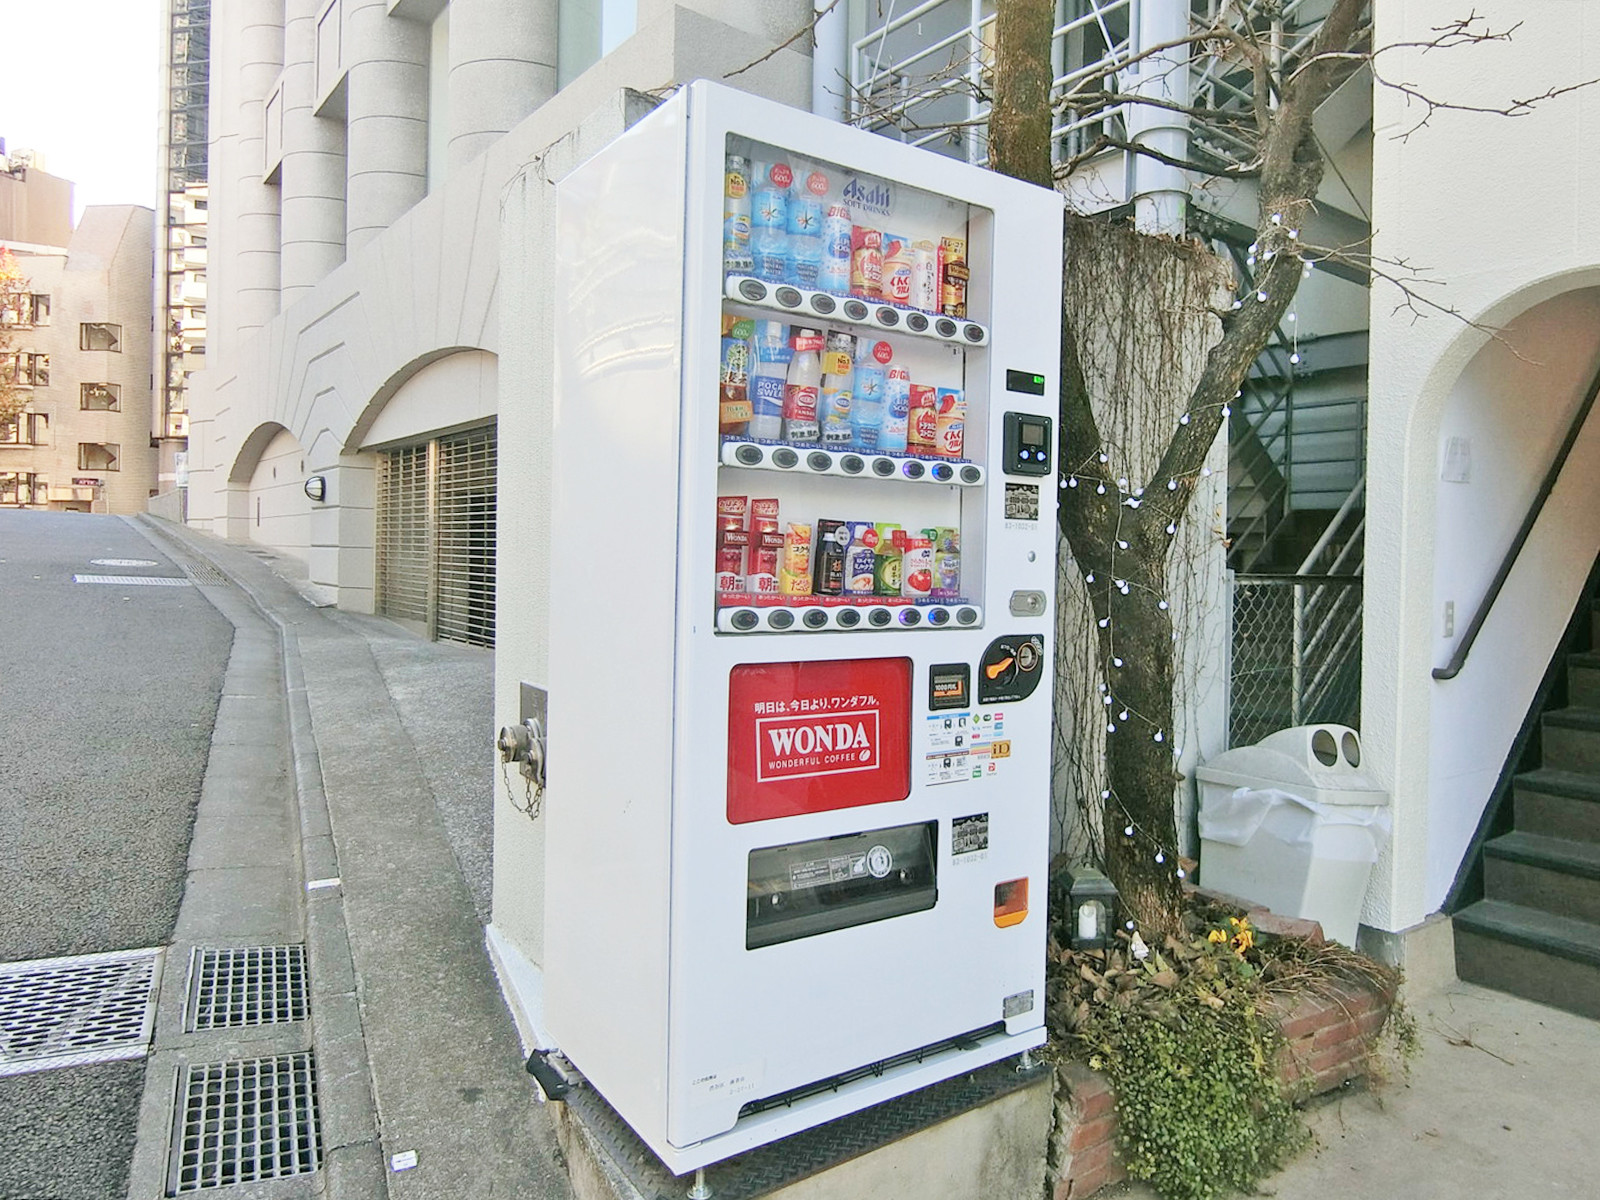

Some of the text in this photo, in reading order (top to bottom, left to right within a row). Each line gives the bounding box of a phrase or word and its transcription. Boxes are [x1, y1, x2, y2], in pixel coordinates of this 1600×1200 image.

[843, 178, 890, 207] Asahi
[843, 198, 891, 216] SOFT DRINKS
[720, 576, 735, 591] 朝
[758, 577, 772, 591] 朝
[754, 695, 880, 714] 明日は、今日より、ワンダフル。
[768, 721, 870, 756] WONDA
[768, 753, 855, 769] WONDERFUL COFFEE
